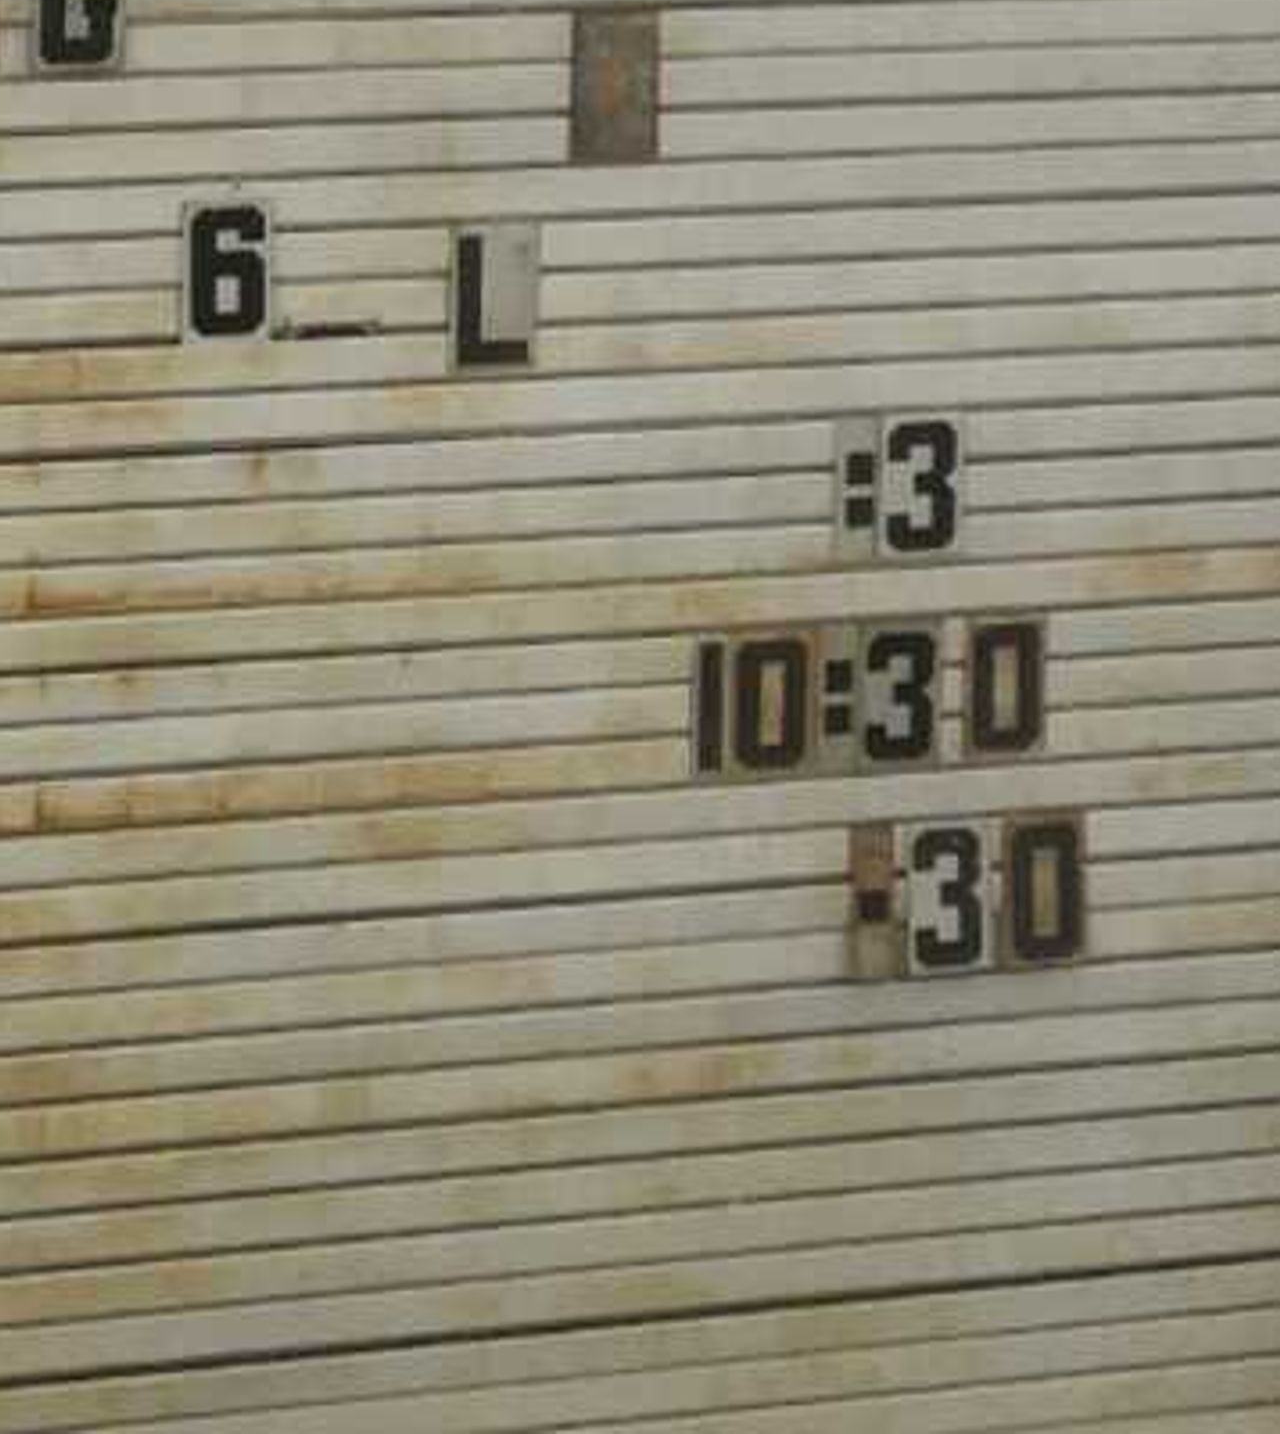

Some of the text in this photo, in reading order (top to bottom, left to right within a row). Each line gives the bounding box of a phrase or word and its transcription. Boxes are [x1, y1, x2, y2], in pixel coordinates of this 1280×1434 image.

[189, 204, 530, 364] 6 L
[844, 420, 959, 552] :3
[697, 621, 1045, 773] 10:30
